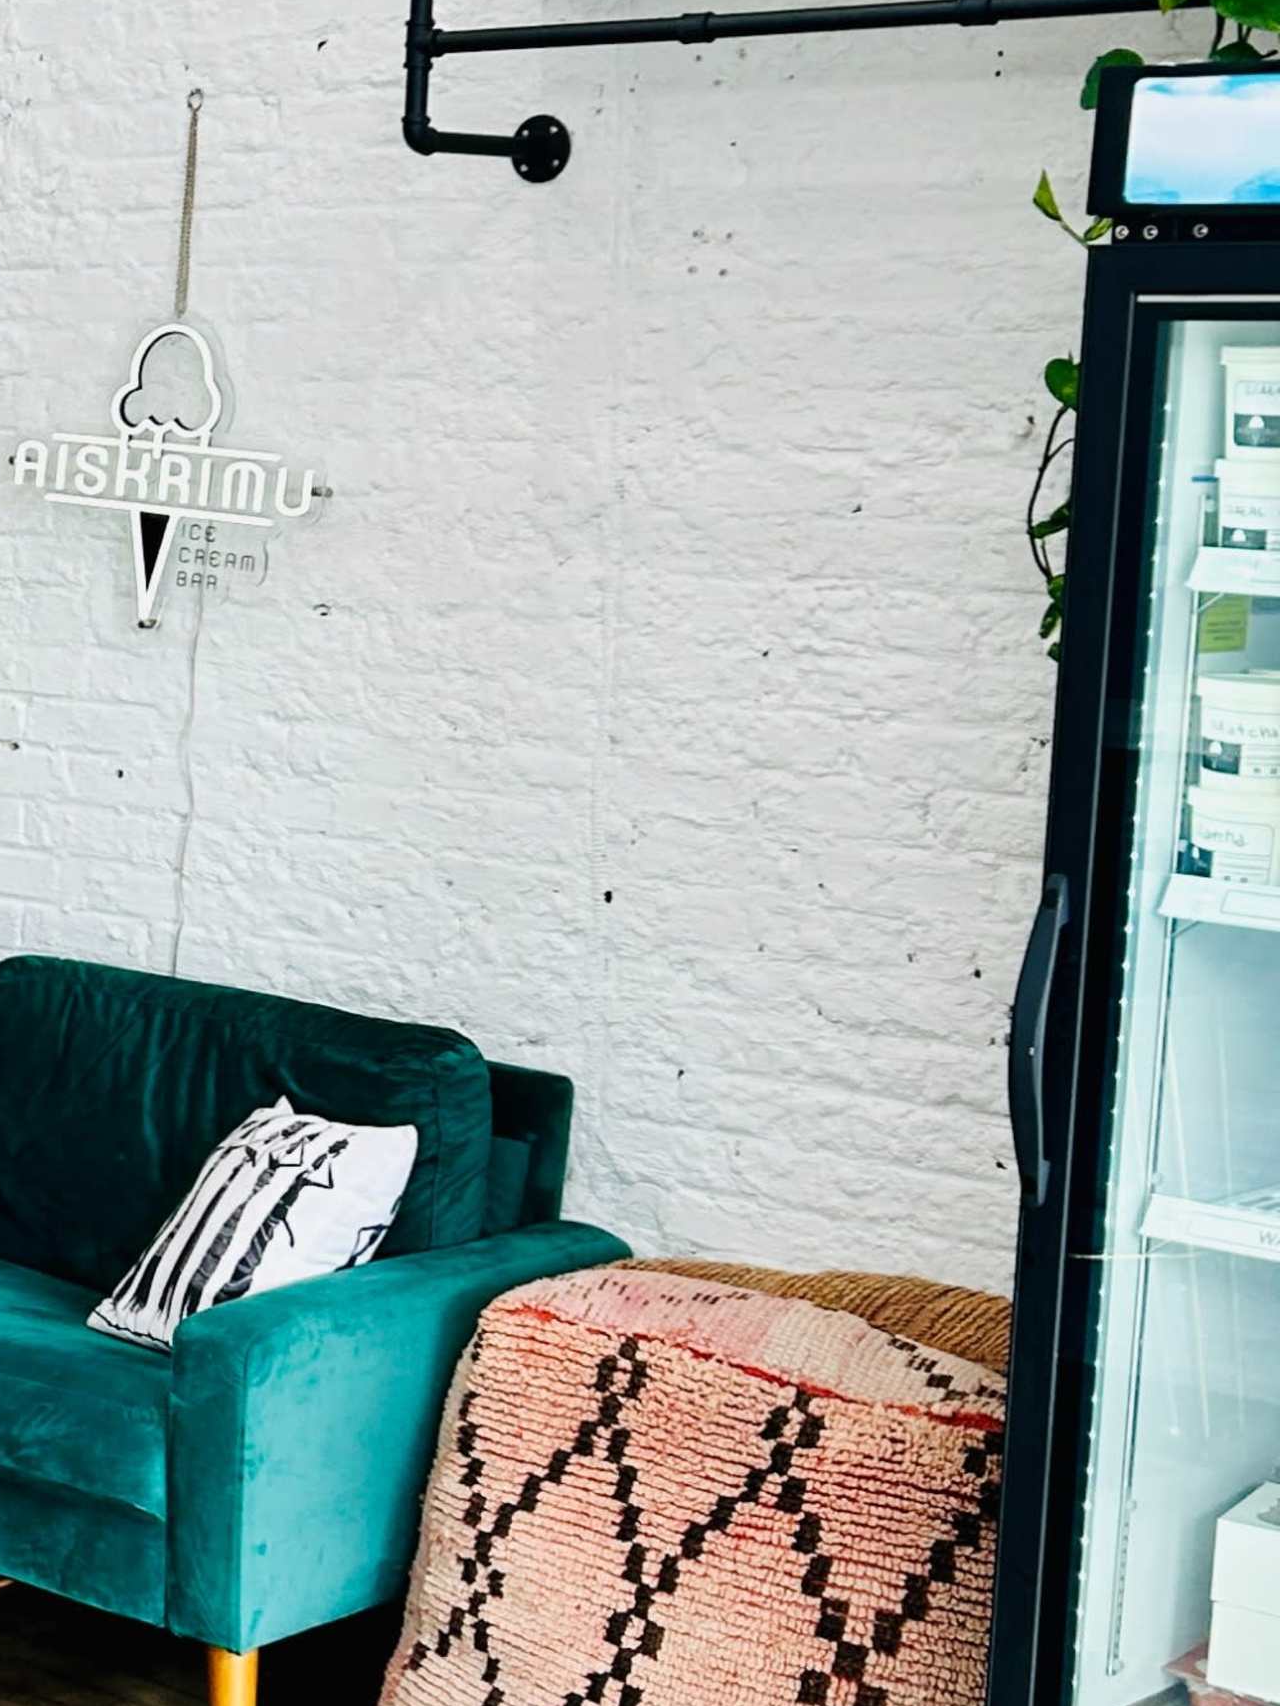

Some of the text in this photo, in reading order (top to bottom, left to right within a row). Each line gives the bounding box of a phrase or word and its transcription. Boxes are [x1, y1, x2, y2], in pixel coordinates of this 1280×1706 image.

[13, 439, 316, 518] AISKRIMU
[180, 523, 217, 543] ICE
[177, 547, 256, 573] CREAM
[175, 570, 218, 590] BAR
